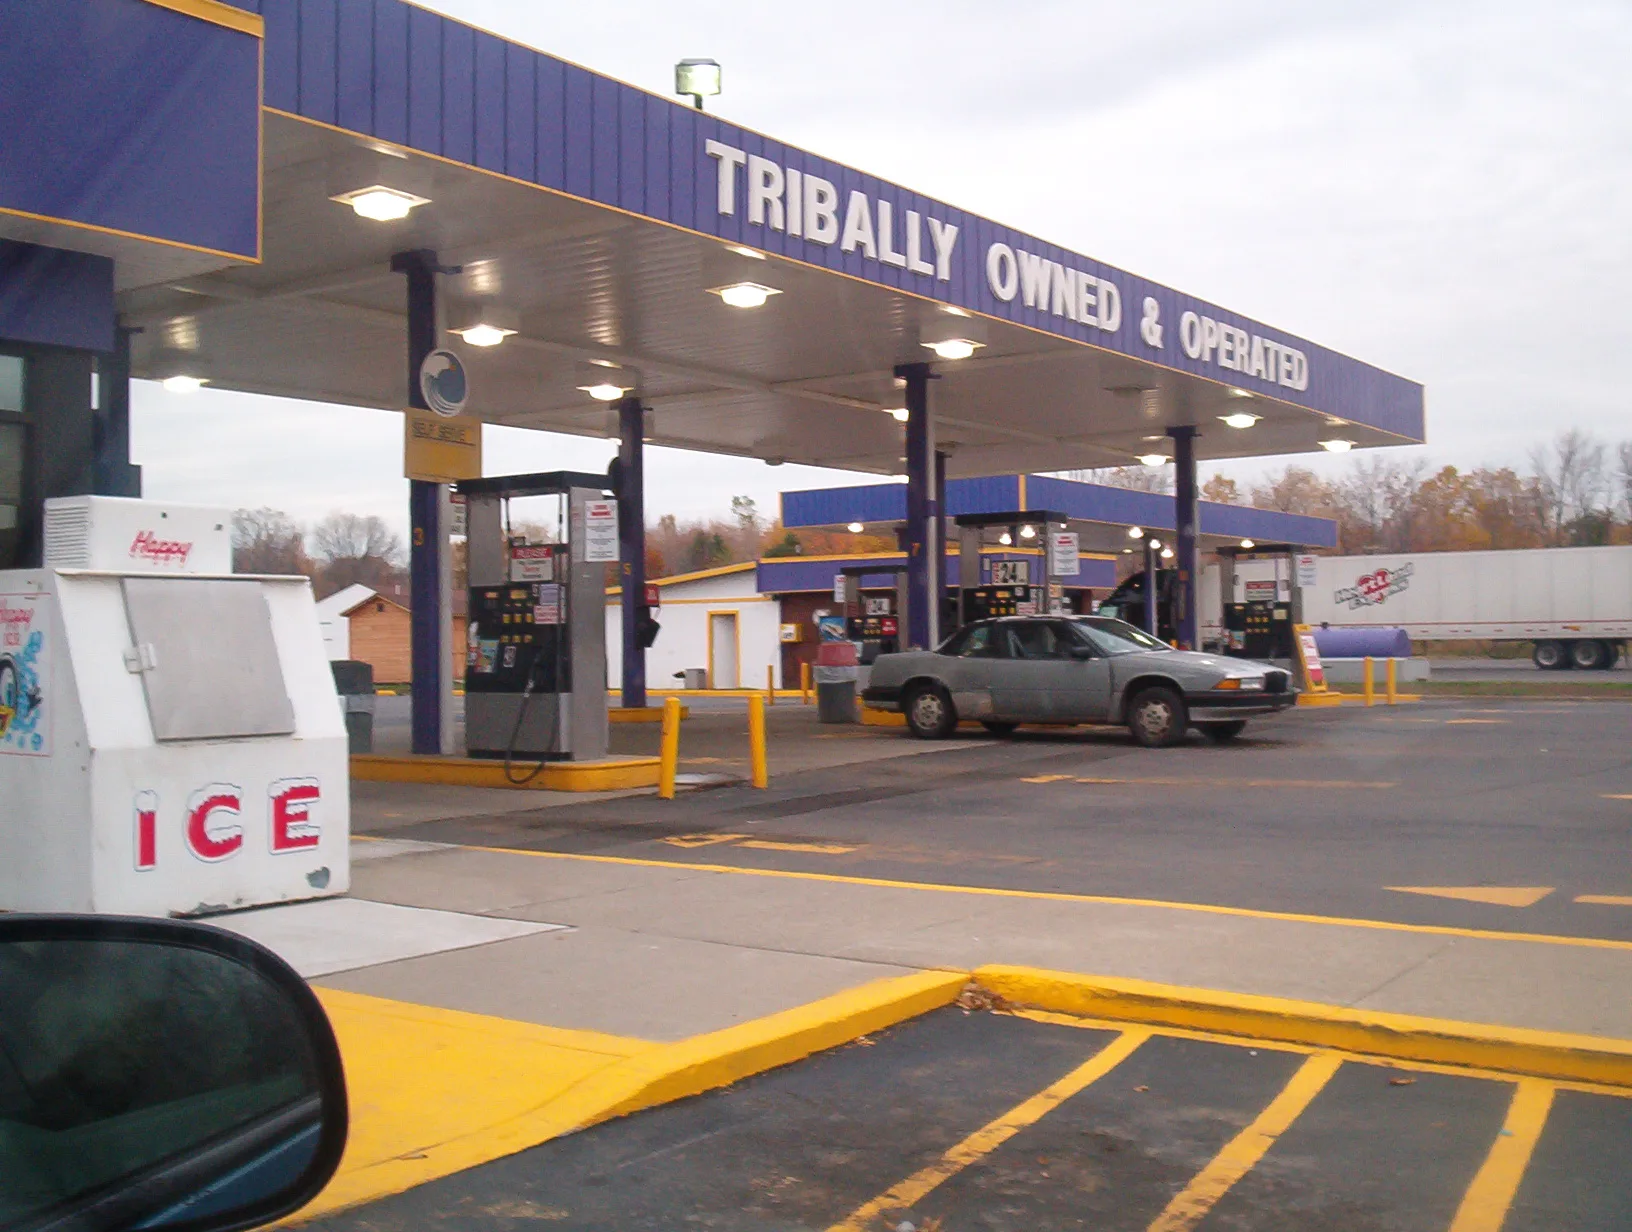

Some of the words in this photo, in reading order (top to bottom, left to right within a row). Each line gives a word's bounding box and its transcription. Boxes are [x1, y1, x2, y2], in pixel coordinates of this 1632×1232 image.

[705, 138, 958, 282] TRIBALLY
[985, 241, 1122, 334] OWNED
[1139, 295, 1164, 349] &
[1179, 310, 1309, 392] OPERATED
[129, 531, 192, 568] Happy
[133, 776, 321, 872] ICE
